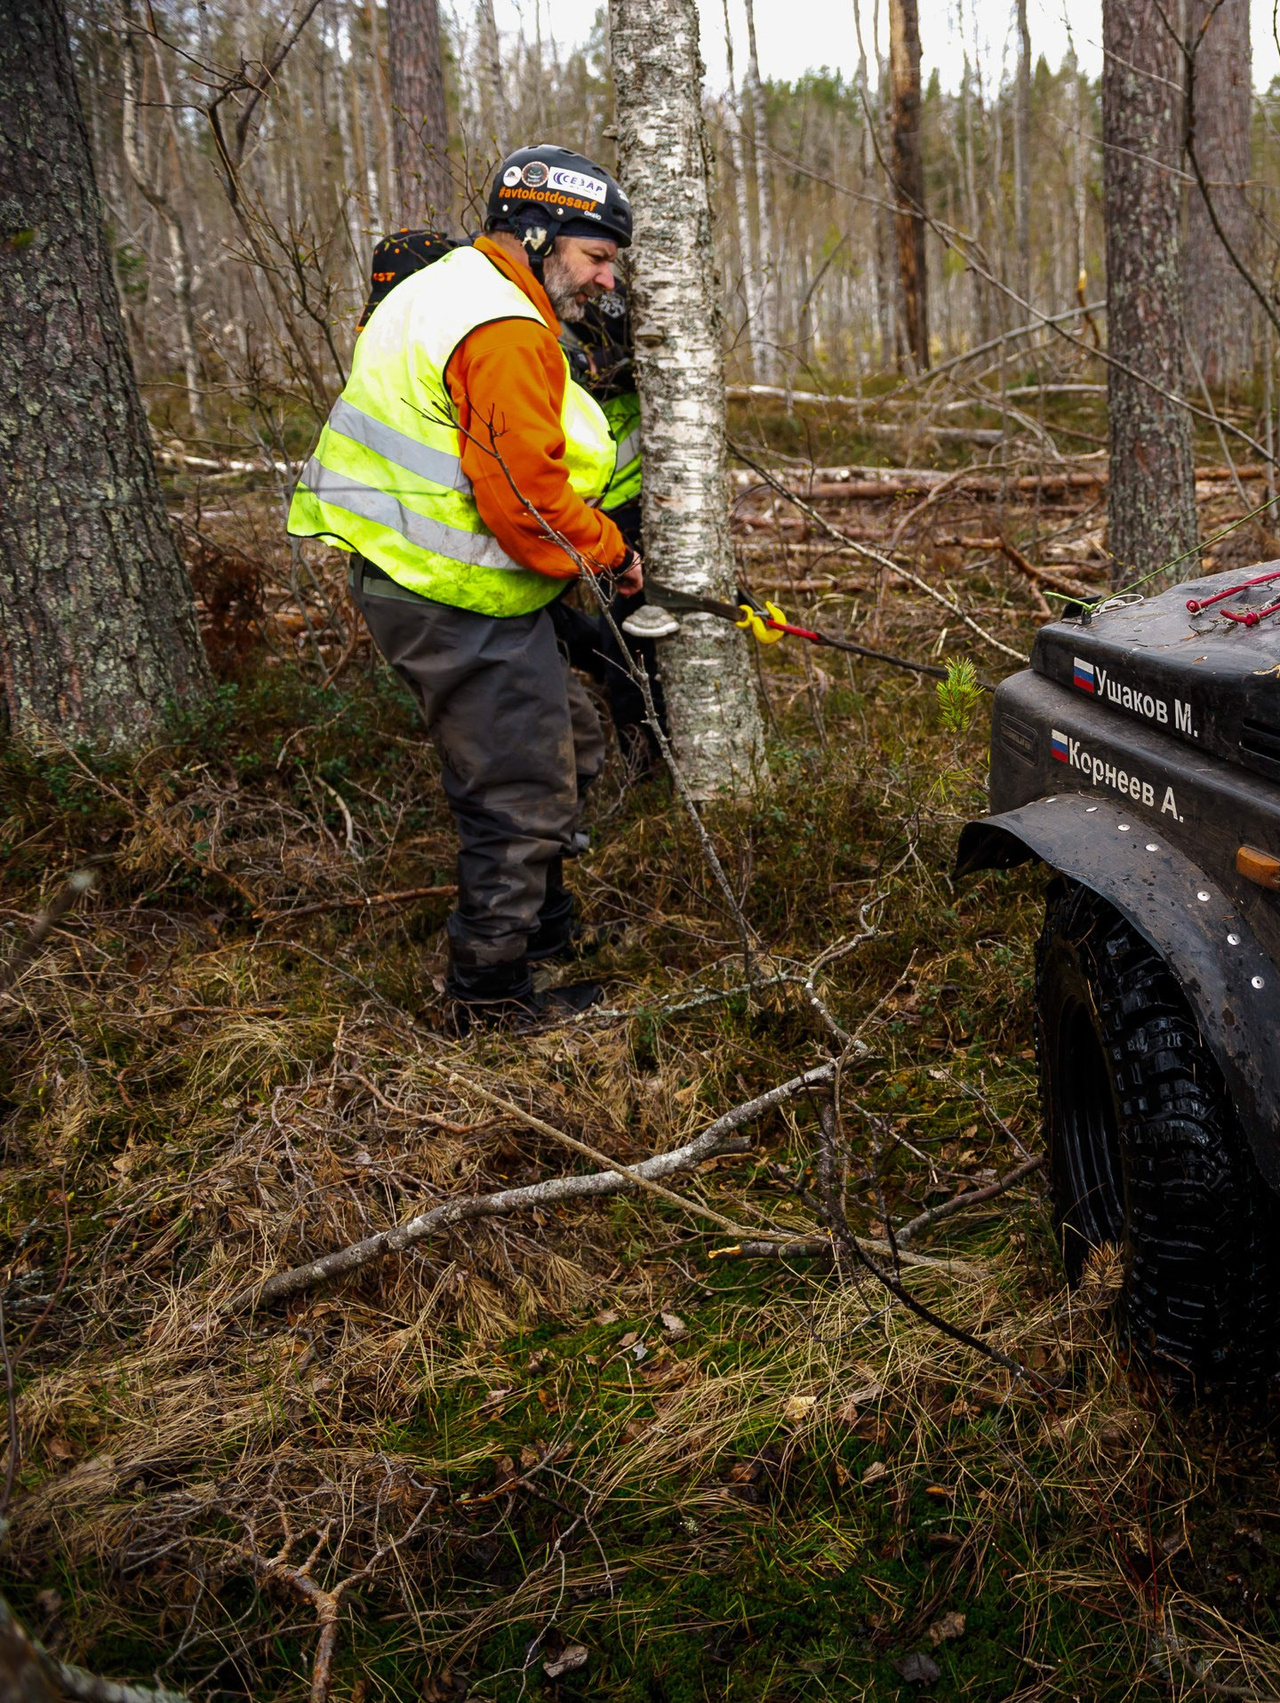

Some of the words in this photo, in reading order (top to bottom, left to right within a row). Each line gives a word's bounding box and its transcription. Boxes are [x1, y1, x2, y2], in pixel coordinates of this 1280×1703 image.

[499, 186, 598, 212] #avtokotdosaaf
[1095, 665, 1169, 724] Ушаков
[1174, 698, 1199, 738] М.
[1068, 737, 1155, 807] Корнеев
[1160, 785, 1184, 823] А.
